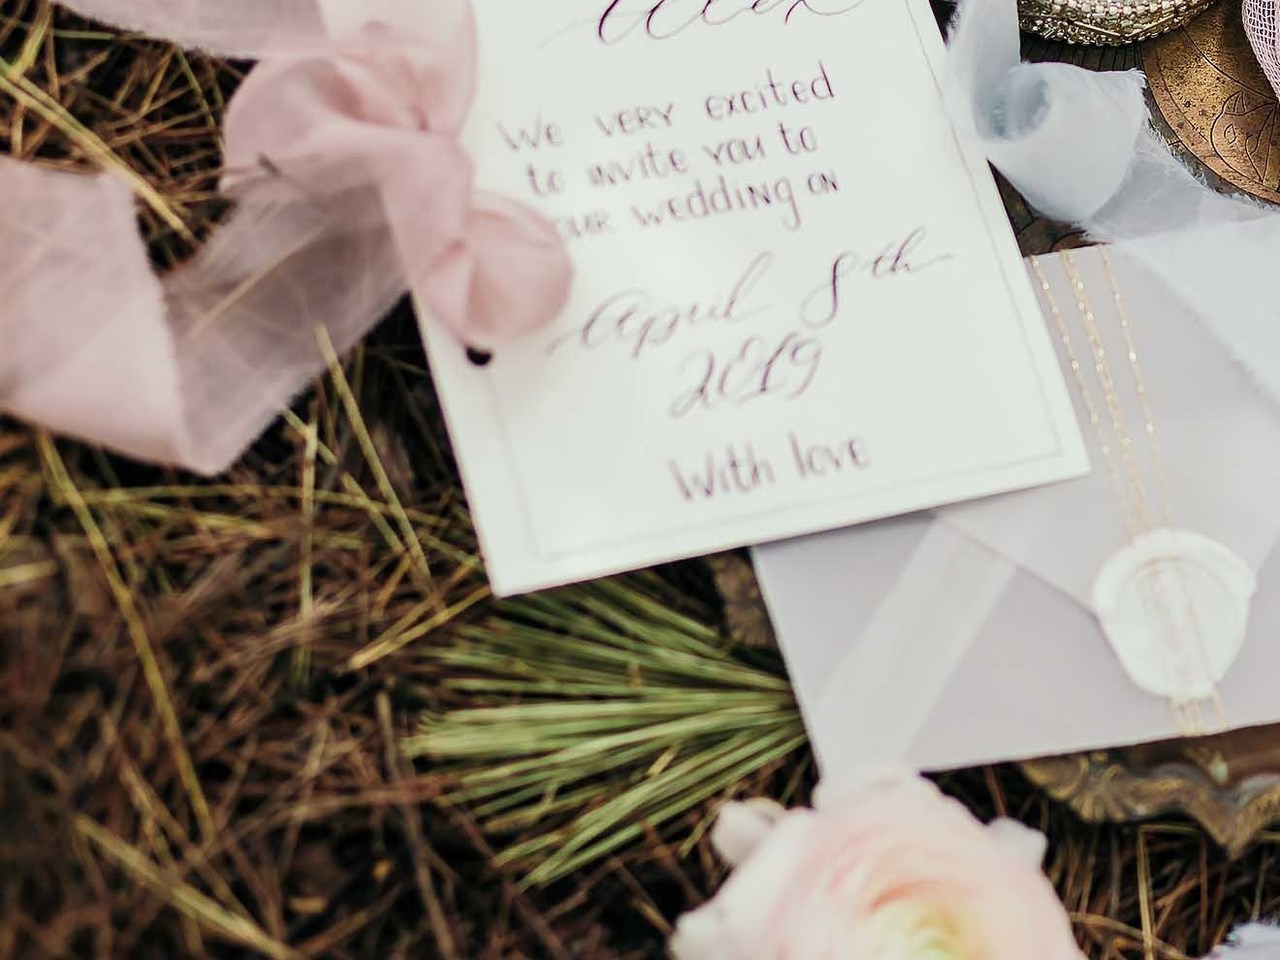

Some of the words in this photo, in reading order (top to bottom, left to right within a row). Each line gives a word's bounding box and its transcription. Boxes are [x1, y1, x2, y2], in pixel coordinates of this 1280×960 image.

[496, 112, 562, 151] We
[705, 60, 835, 120] excited
[526, 162, 563, 198] to
[587, 141, 688, 187] invite
[702, 134, 765, 165] you
[778, 120, 818, 155] to
[631, 173, 801, 231] wedding
[807, 169, 839, 196] on
[544, 251, 774, 360] April
[668, 331, 824, 418] 2019
[668, 439, 777, 502] With
[788, 431, 871, 478] love
